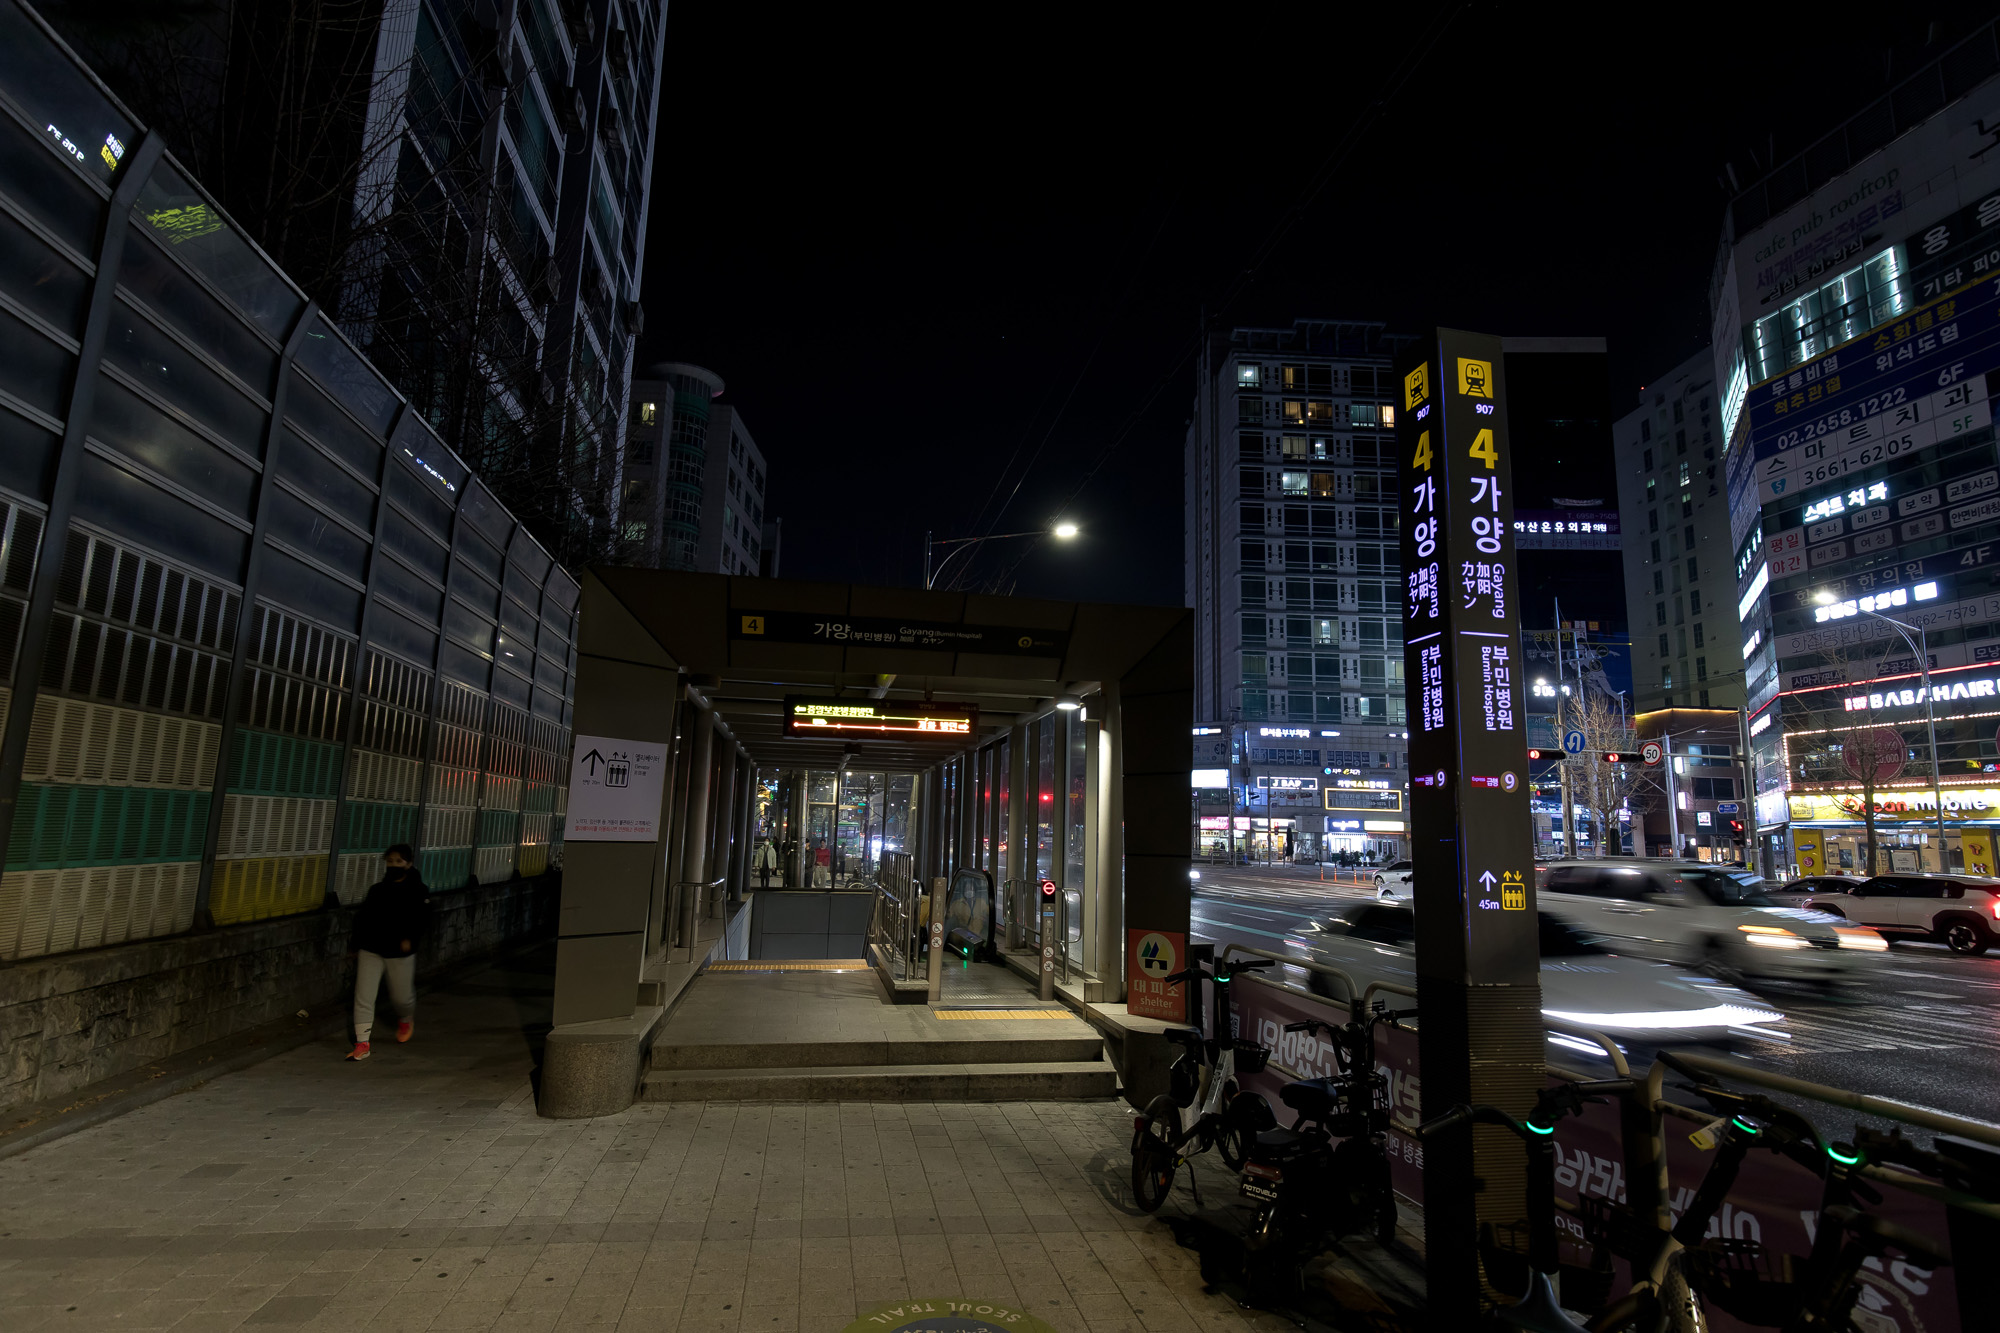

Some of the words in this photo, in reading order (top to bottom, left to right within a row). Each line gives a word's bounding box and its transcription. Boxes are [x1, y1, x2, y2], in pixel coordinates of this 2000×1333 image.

[1755, 235, 1786, 264] cafe
[1791, 212, 1823, 241] pub
[1829, 166, 1900, 219] rooftop
[1417, 405, 1430, 421] 907
[1475, 403, 1494, 415] 907
[1777, 387, 1908, 451] 02.2658.1222
[1937, 362, 1965, 388] 6F
[1412, 429, 1433, 472] 4
[1469, 428, 1498, 470] 4
[1804, 435, 1913, 486] 3661-6205
[1953, 415, 1973, 433] 5F
[1949, 475, 1996, 498] 교통사고
[1413, 476, 1438, 558] 가양
[1470, 476, 1504, 554] 가양
[1770, 533, 1799, 552] 평일
[1772, 557, 1801, 576] 야간
[1960, 546, 1991, 566] 4F
[1428, 562, 1439, 618] Gayang
[1461, 560, 1477, 609] カヤン
[1491, 563, 1505, 618] Gayang
[747, 619, 758, 632] 4
[1909, 605, 1977, 627] 3662-7579
[813, 621, 850, 640] 가양
[900, 626, 934, 638] Gayang
[1421, 649, 1430, 685] Bumin
[1481, 646, 1493, 682] Bumin
[1429, 644, 1444, 729] 부민병원
[1492, 645, 1514, 730] 부민병원
[1423, 686, 1433, 732] Hospital
[1483, 684, 1497, 731] Hospital
[1646, 749, 1658, 759] 50
[1437, 771, 1445, 787] 9
[1504, 773, 1515, 789] 9
[1479, 900, 1500, 910] 45m
[1134, 979, 1179, 997] 대피소
[1140, 996, 1173, 1008] shelter
[868, 1302, 935, 1324] TRAIL
[946, 1301, 1022, 1322] SEOUL
